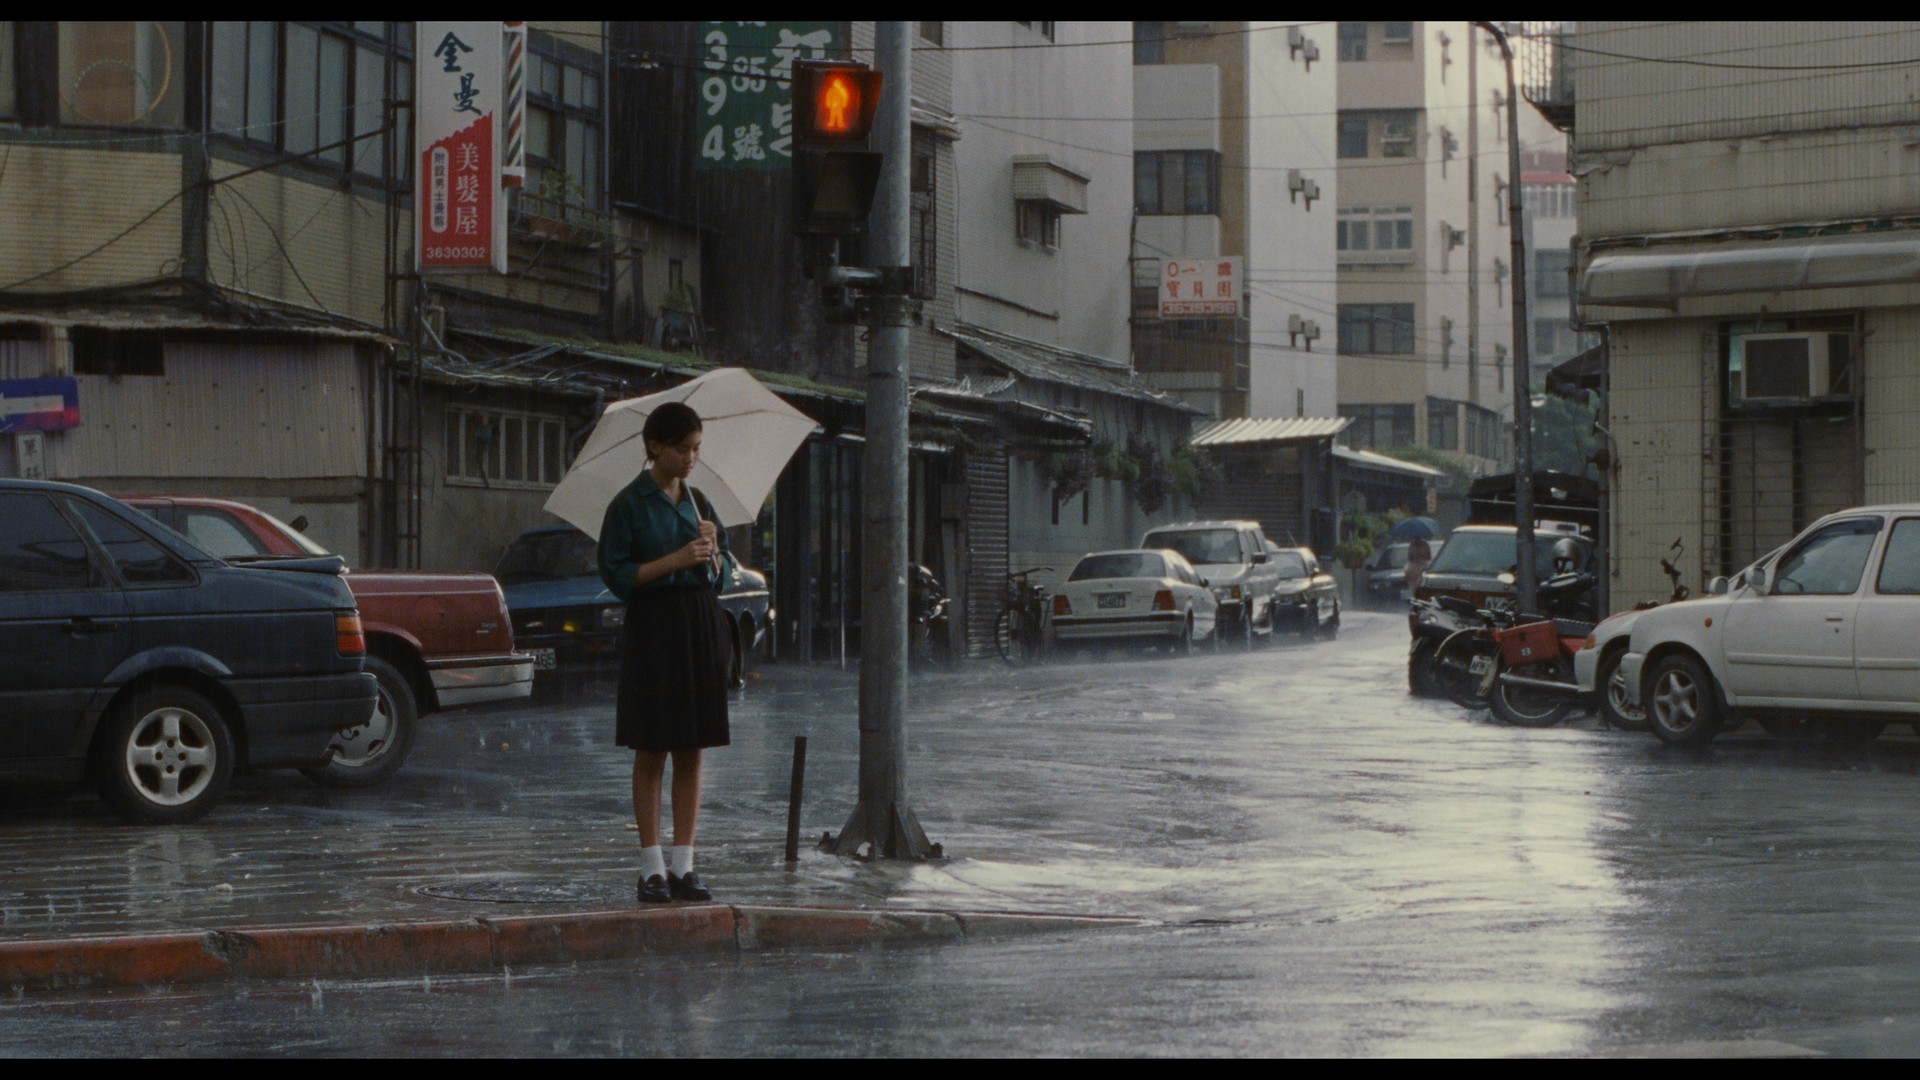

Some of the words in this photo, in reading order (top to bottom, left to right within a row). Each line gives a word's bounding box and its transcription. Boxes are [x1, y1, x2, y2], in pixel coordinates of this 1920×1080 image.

[702, 21, 727, 161] 394
[731, 21, 767, 161] 85號
[454, 143, 480, 235] 美髮屋
[426, 246, 486, 258] 3630302
